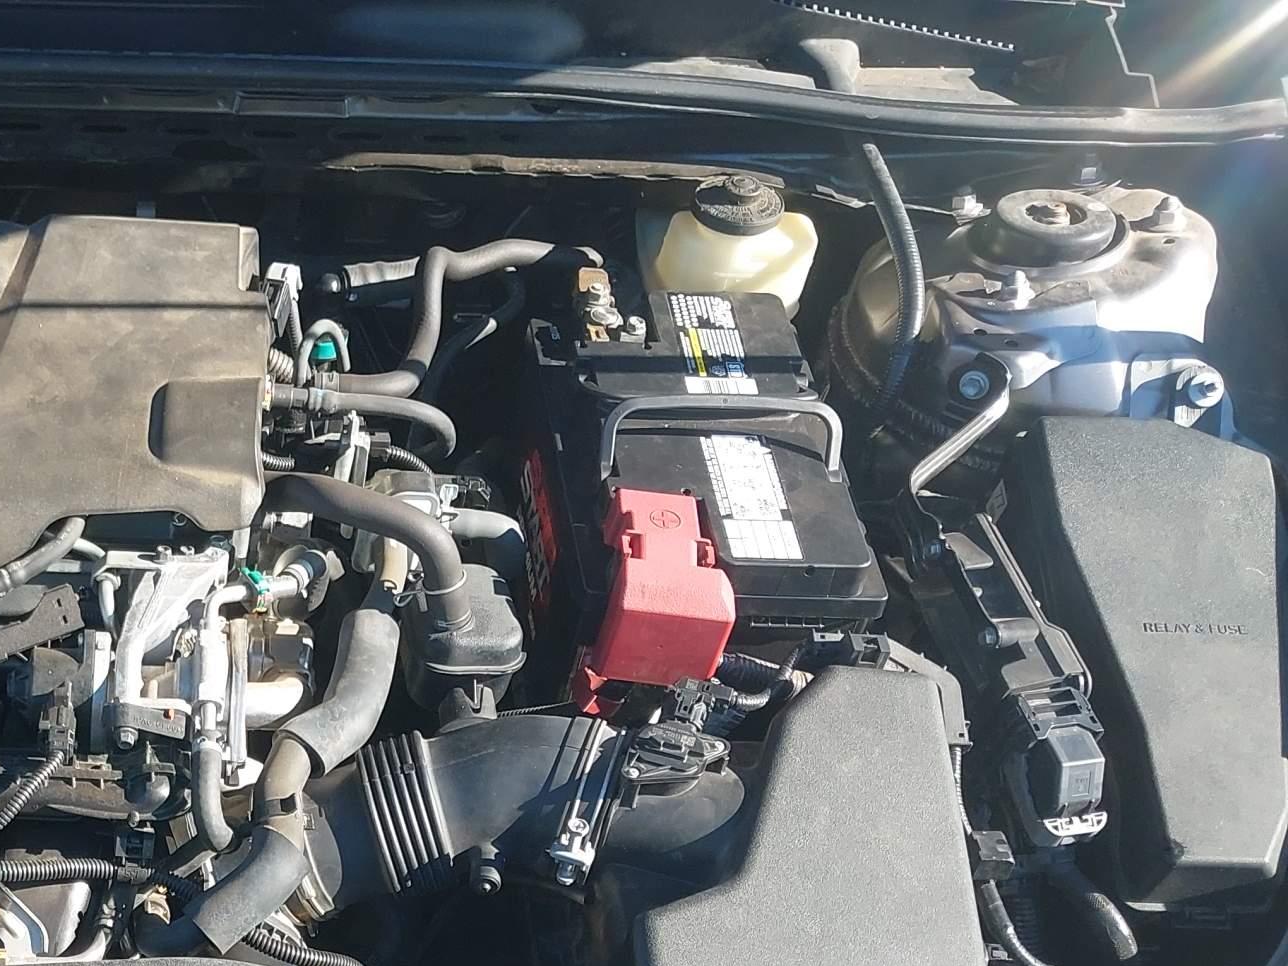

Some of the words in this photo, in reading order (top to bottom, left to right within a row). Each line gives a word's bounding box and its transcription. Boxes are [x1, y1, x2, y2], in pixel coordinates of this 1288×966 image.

[1142, 622, 1191, 633] RELAY
[1195, 623, 1204, 633] &
[1208, 624, 1248, 635] FUSE
